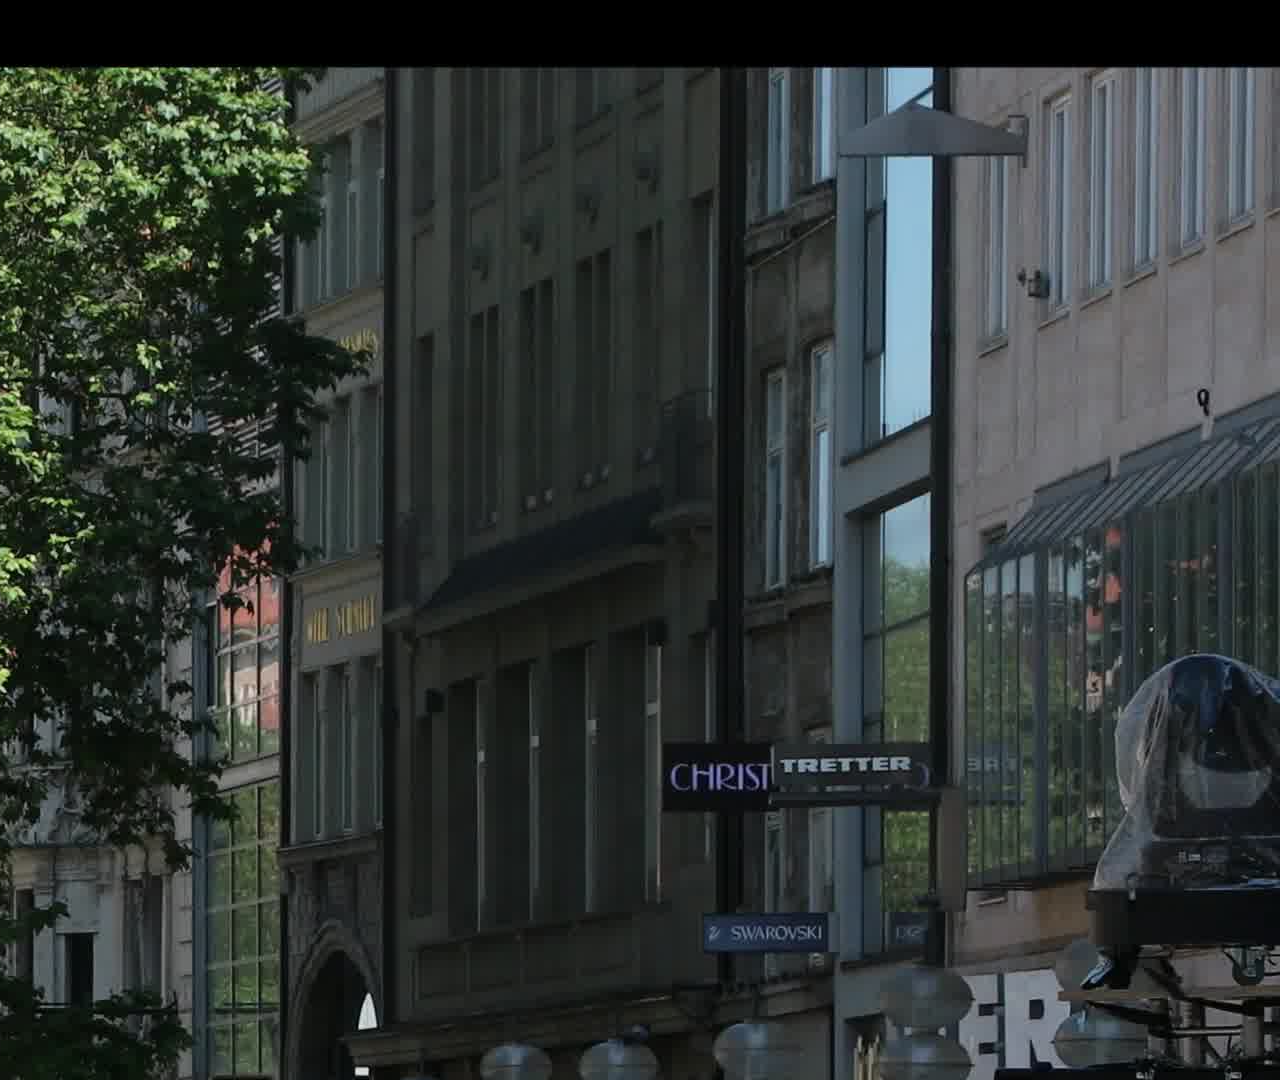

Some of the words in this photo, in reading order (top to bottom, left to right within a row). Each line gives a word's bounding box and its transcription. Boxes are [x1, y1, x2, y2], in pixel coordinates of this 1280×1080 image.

[780, 756, 911, 773] TRETTER
[671, 763, 771, 791] CHRIST
[730, 926, 822, 941] SWAROVSKI
